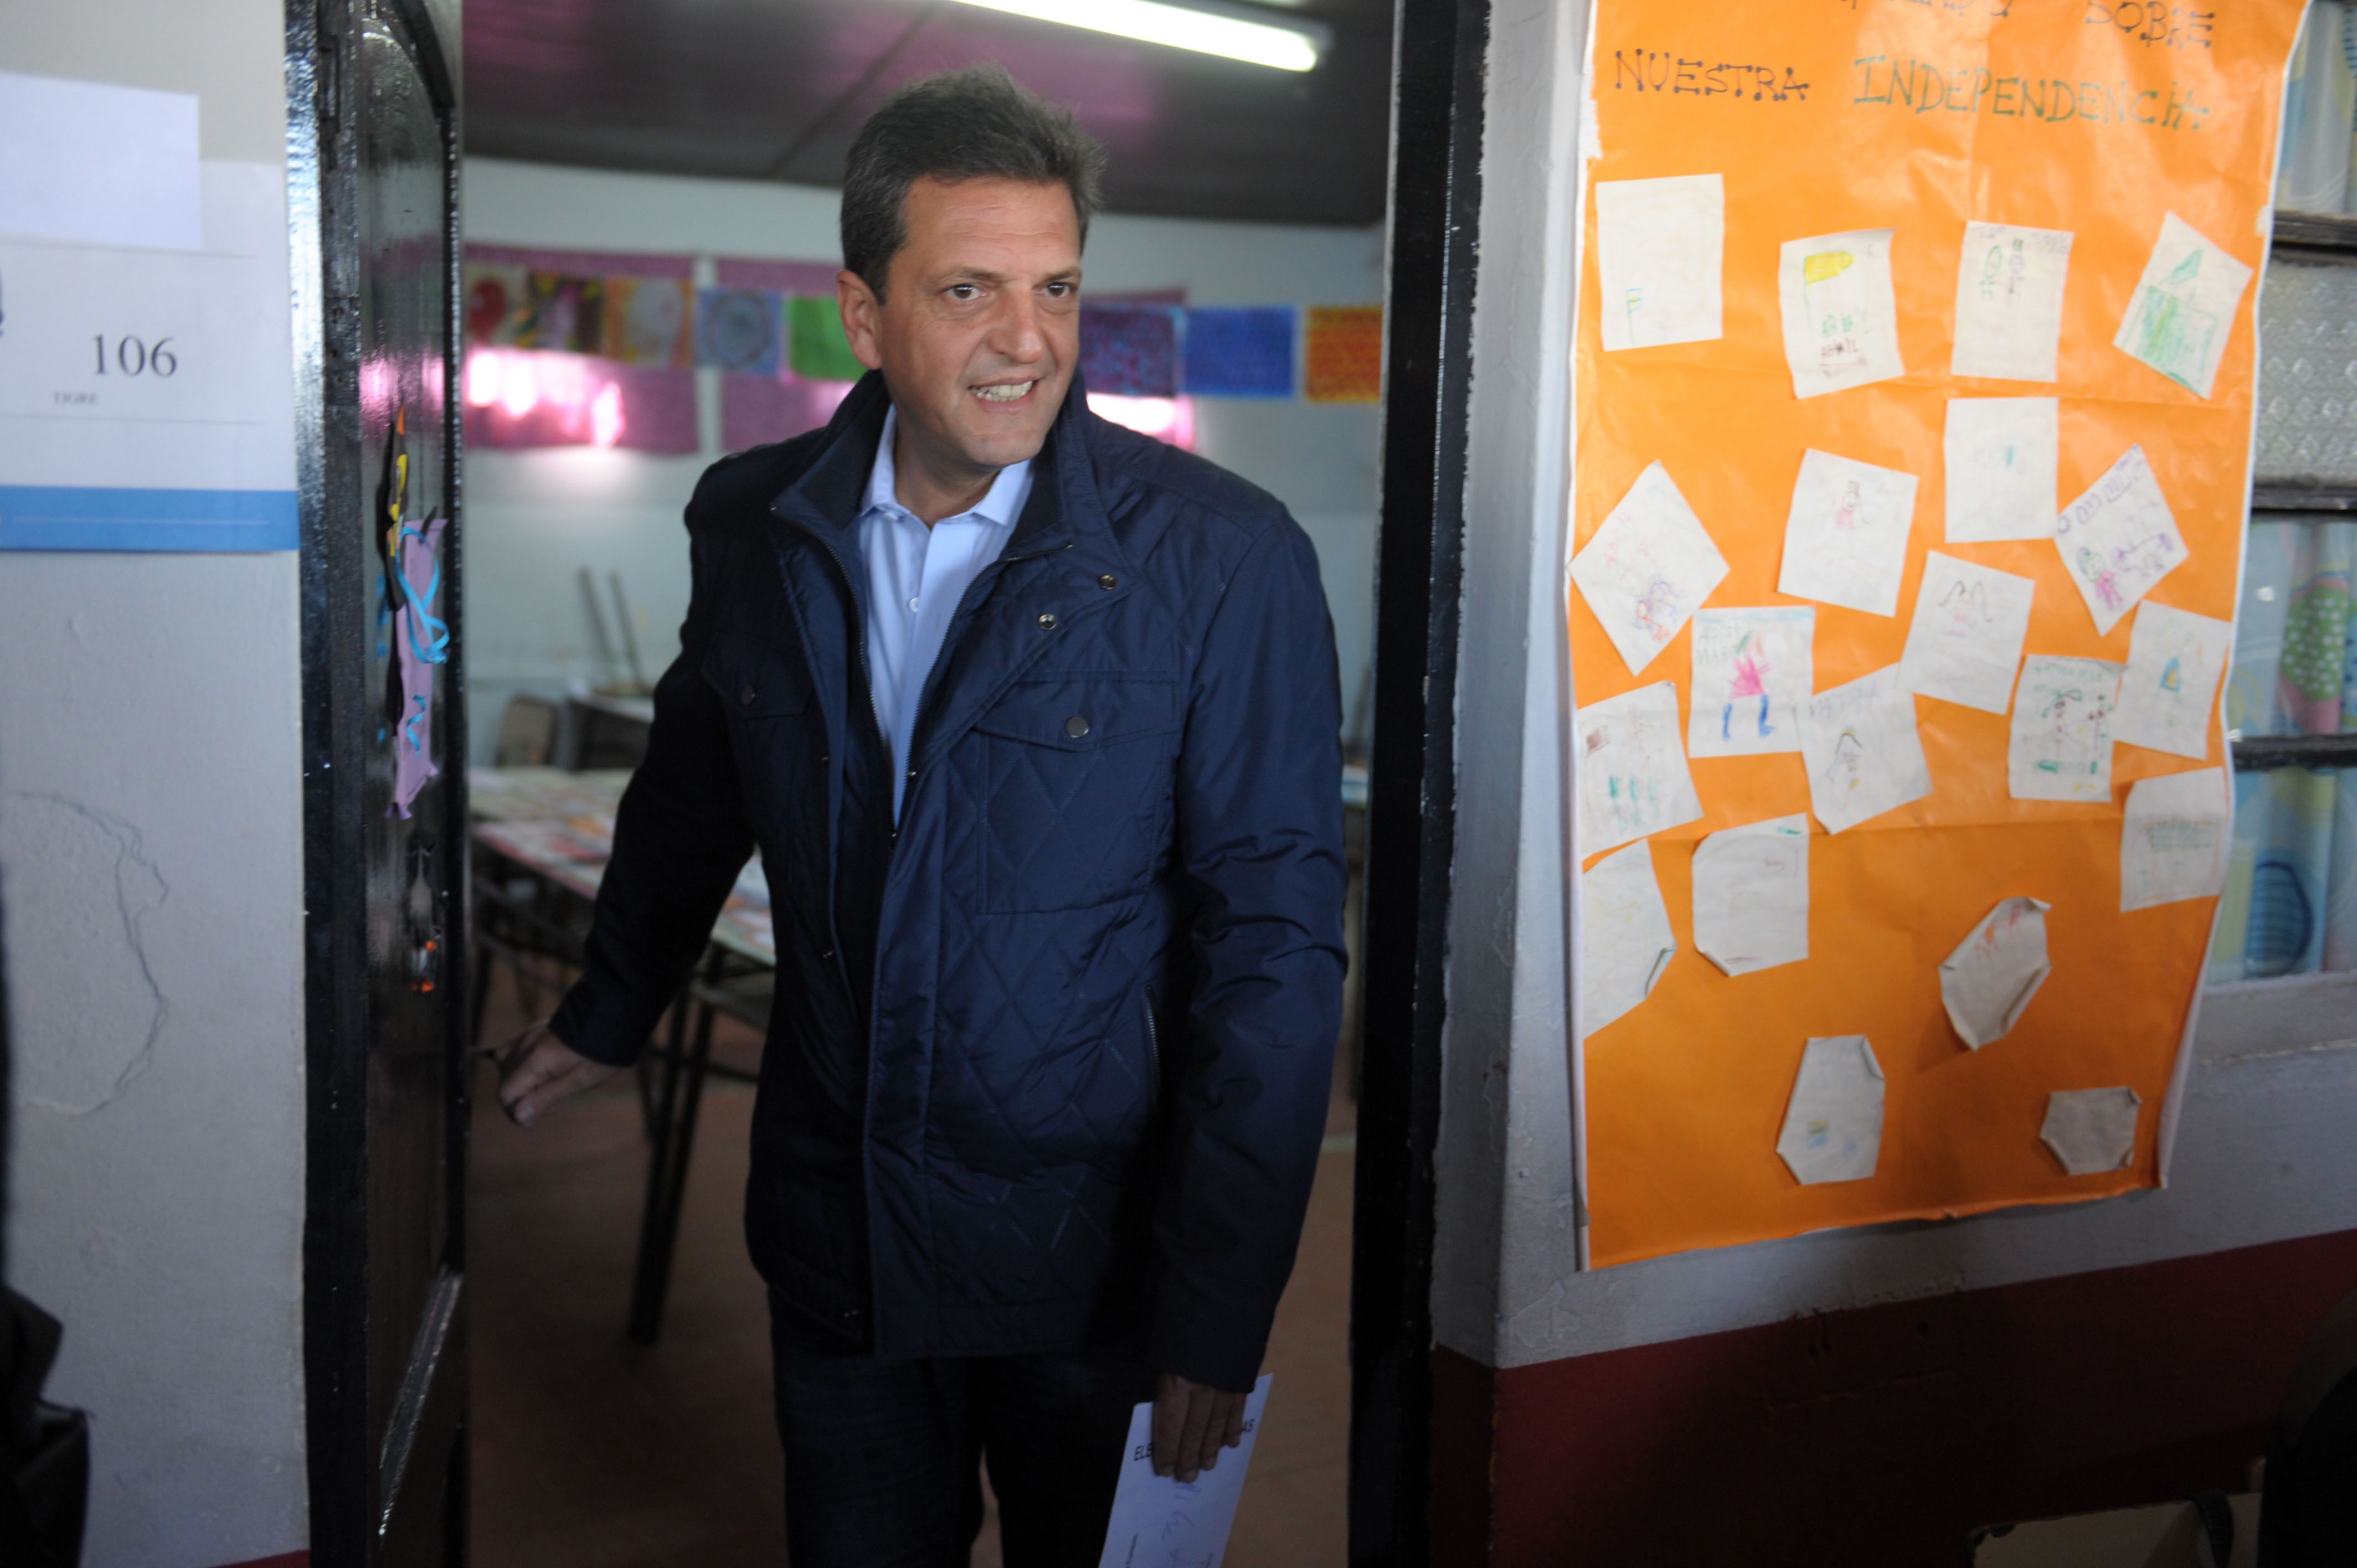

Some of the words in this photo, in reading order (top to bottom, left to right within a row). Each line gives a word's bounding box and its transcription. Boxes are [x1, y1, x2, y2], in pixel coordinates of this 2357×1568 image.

[1615, 48, 1809, 101] NUESTRA
[1854, 55, 2210, 130] INDEPENDENCIA
[92, 333, 177, 377] 106
